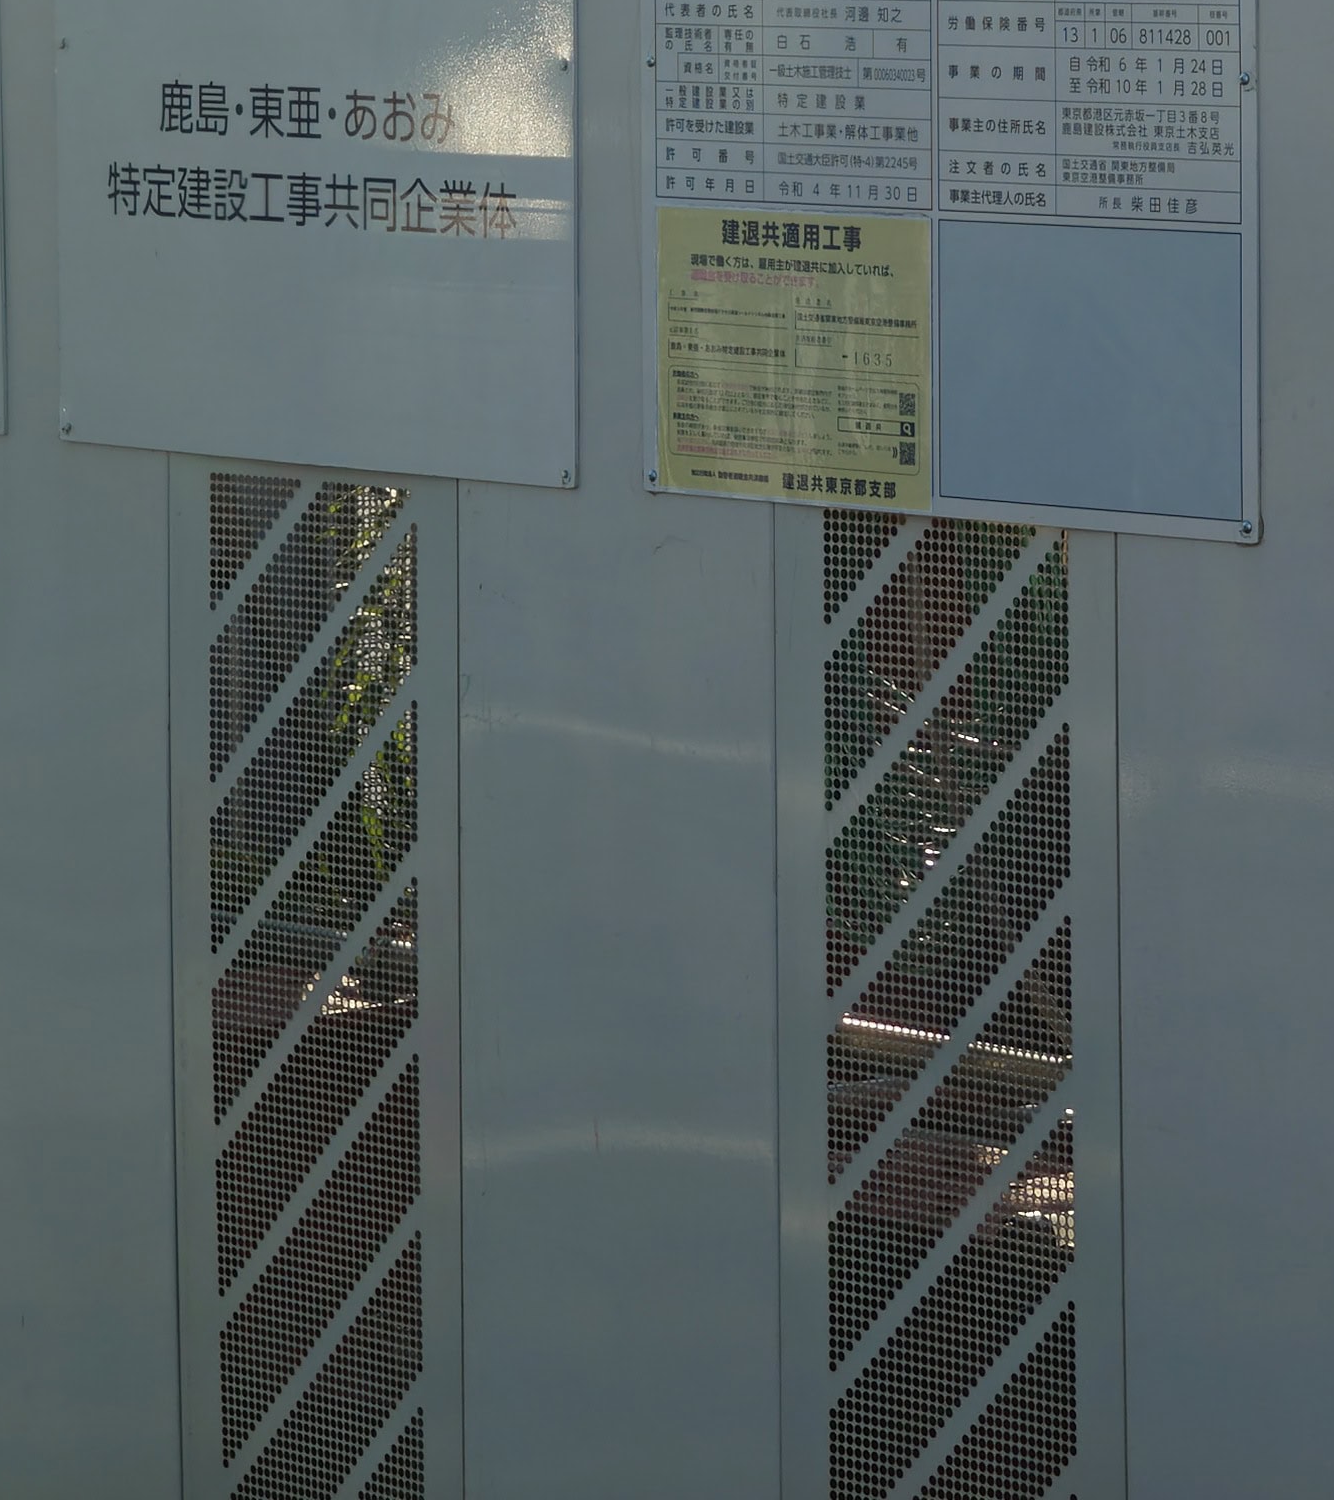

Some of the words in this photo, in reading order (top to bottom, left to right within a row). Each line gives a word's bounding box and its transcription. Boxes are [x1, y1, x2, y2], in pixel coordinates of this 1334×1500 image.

[665, 4, 753, 18] 代表者の氏名
[878, 7, 902, 22] 知之
[948, 16, 1045, 31] 労働保険番号
[665, 28, 712, 40] 監理技術者
[724, 29, 753, 40] 専任の
[1063, 26, 1078, 42] 13
[1093, 28, 1097, 42] 1
[1110, 28, 1127, 43] 06
[1139, 29, 1191, 45] 811428
[1206, 30, 1230, 45] 001
[665, 40, 712, 51] の氏名
[724, 42, 753, 52] 有無
[778, 35, 810, 49] 白石
[845, 36, 856, 51] 浩
[897, 37, 907, 52] 有
[684, 62, 713, 74] 資格名
[948, 65, 1045, 81] 事業の期間
[666, 87, 753, 98] 一般建設業又は
[666, 98, 754, 111] 特定建設業の別
[778, 93, 865, 110] 特定建設業
[160, 80, 455, 144] 鹿島・東亜・あおみ
[1062, 108, 1219, 124] 東京都港区元赤坂一丁目3番8号
[666, 118, 754, 135] 許可を受けた建設業
[779, 123, 917, 141] 土木工事業・解体工事業他
[949, 119, 1046, 135] 事業主の住所氏名
[1062, 123, 1147, 138] 鹿島建設株式会社
[1154, 126, 1219, 140] 東京土木支店
[666, 147, 754, 164] 許可番号
[949, 159, 1046, 177] 注文者の氏名
[1063, 159, 1106, 171] 国土交通省
[1112, 161, 1174, 173] 関東地方整備局
[667, 176, 754, 192] 許可年月日
[108, 162, 516, 239] 特定建設工事共同企業体
[950, 189, 1046, 207] 事業主代理人の氏名
[1099, 196, 1121, 210] 所長
[722, 220, 861, 251] 建退共適用工事
[783, 473, 896, 499] 建退共東京都支部
